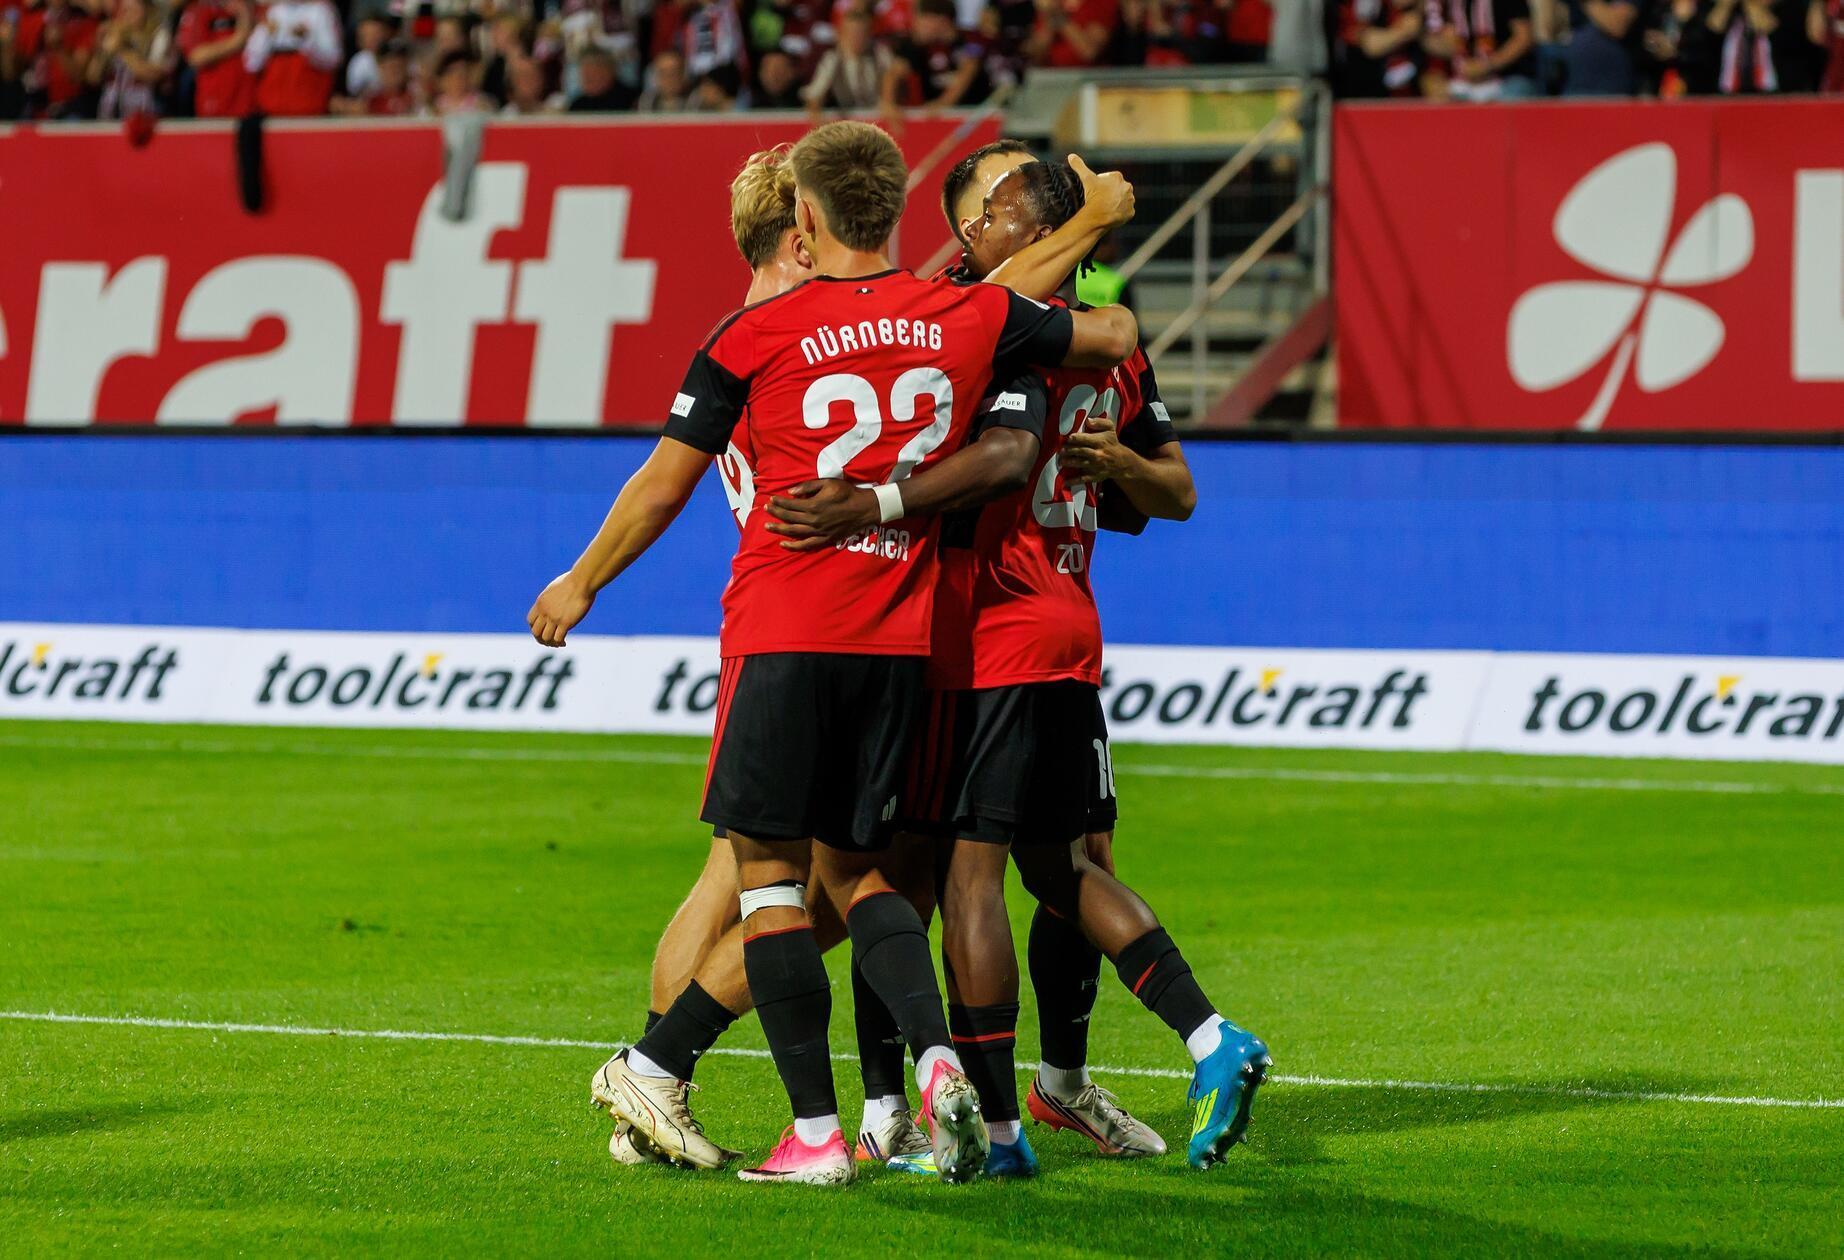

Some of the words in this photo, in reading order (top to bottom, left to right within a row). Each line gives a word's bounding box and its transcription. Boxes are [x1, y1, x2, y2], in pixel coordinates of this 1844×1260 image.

[0, 162, 656, 425] raft
[800, 318, 942, 364] NÜRNBERG
[802, 366, 953, 491] 22
[256, 652, 574, 710] toolcraft
